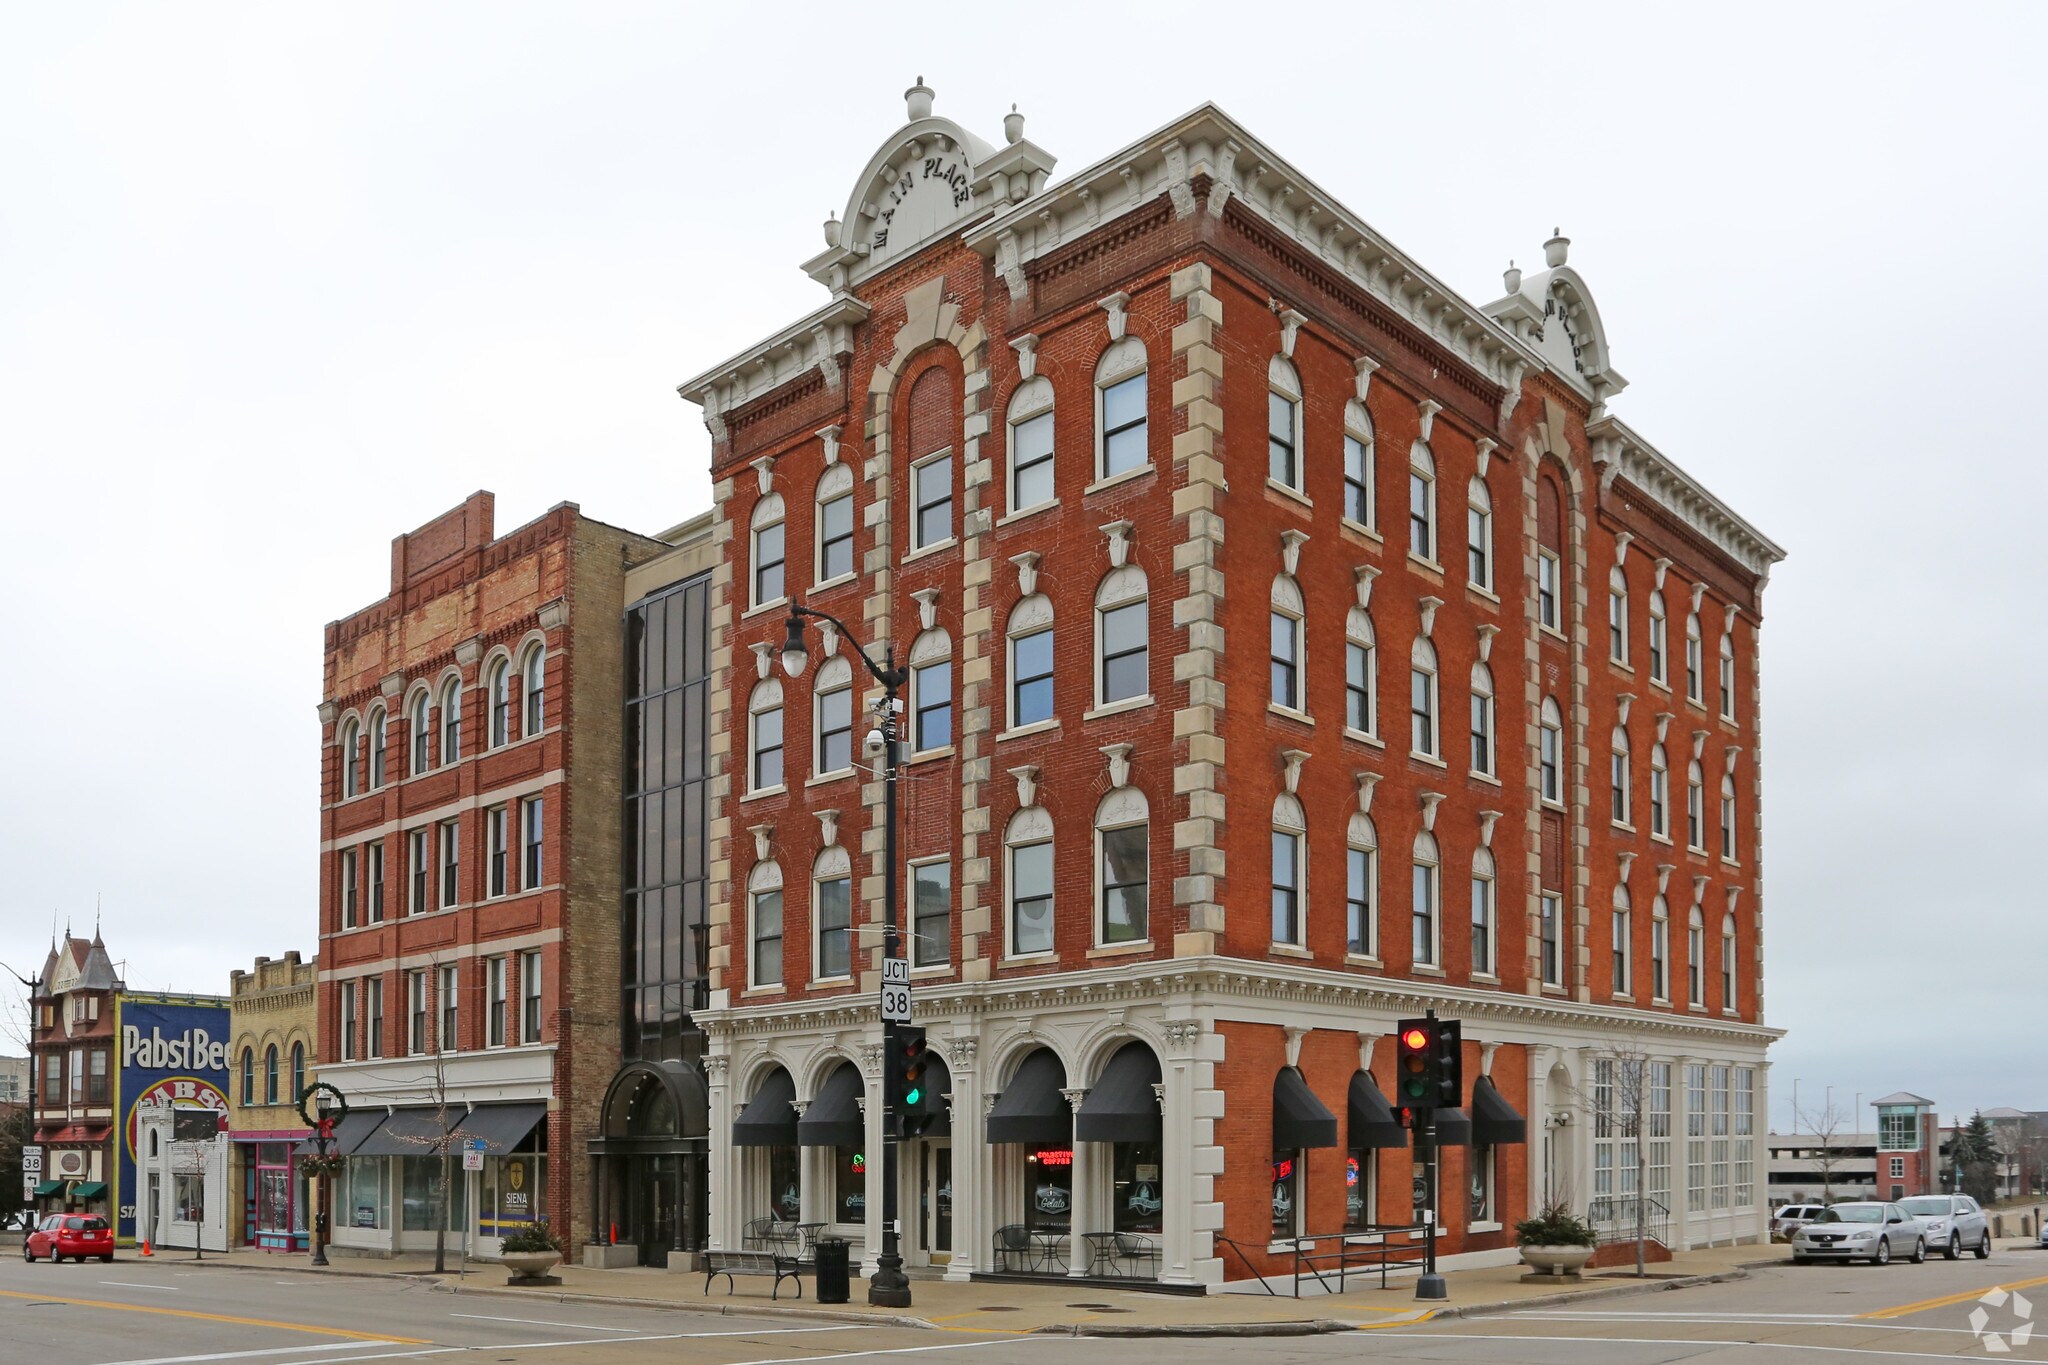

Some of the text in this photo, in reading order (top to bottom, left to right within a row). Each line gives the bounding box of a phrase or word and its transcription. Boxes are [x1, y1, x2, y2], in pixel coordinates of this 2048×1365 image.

[872, 157, 970, 250] MAIN PLACE
[1559, 305, 1584, 374] PLACE
[884, 961, 907, 979] JCT
[885, 991, 907, 1014] 38
[123, 1024, 191, 1070] Pabst
[24, 1158, 40, 1169] 38
[506, 1192, 528, 1204] SIENA
[1040, 1197, 1066, 1208] Gelato
